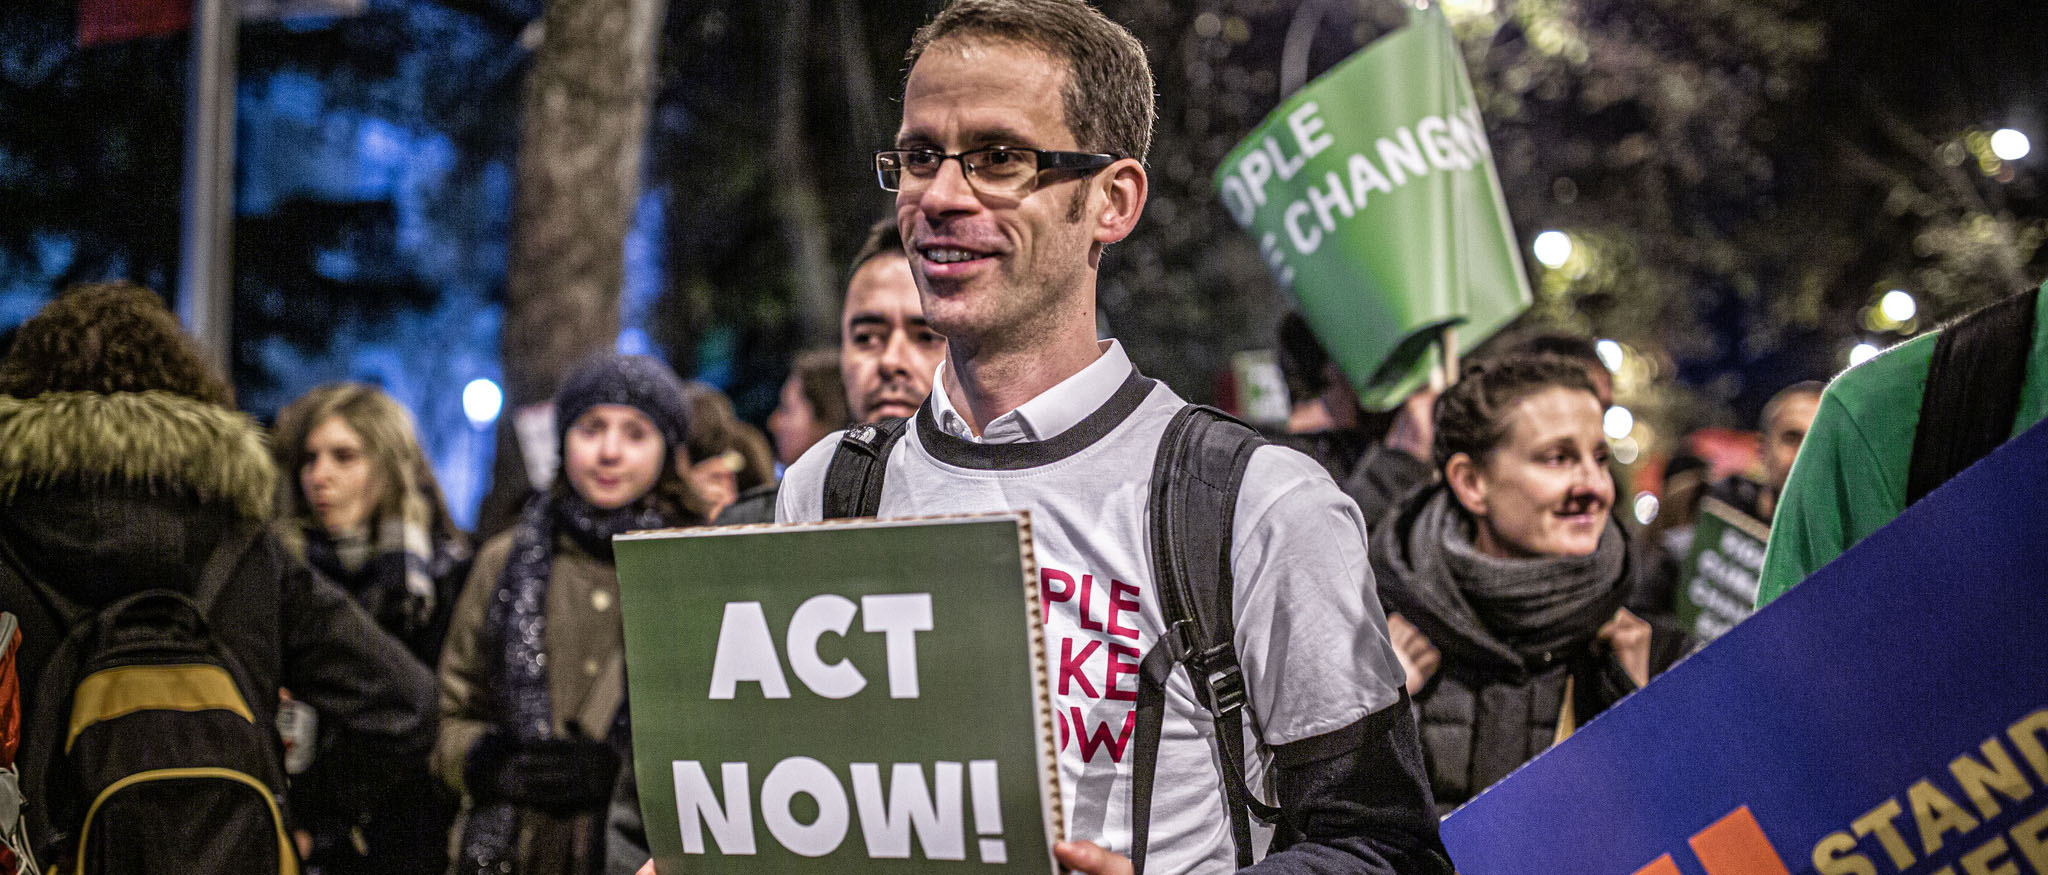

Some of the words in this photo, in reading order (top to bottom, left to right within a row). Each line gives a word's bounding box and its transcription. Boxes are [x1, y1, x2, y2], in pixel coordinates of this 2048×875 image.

[708, 593, 934, 700] ACT
[1040, 567, 1140, 640] PLE
[1058, 637, 1140, 702] KE
[672, 755, 1008, 864] NOW!
